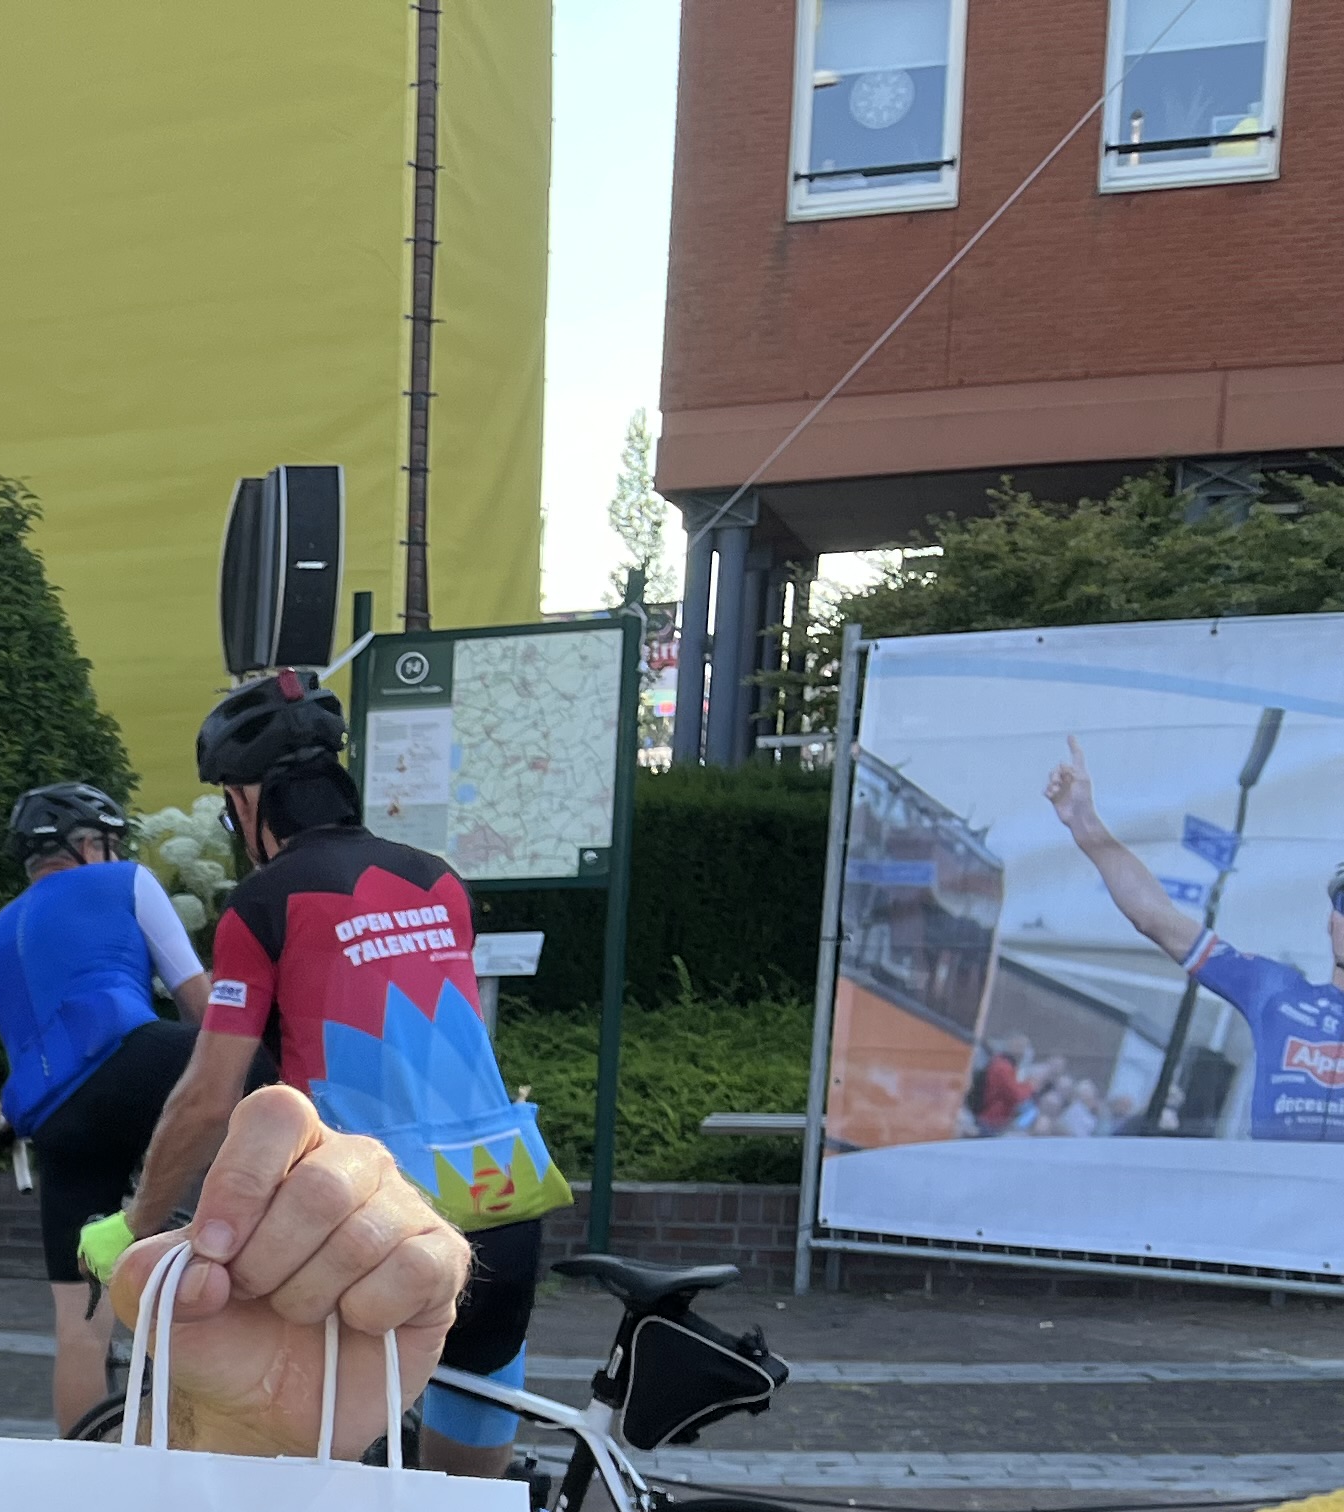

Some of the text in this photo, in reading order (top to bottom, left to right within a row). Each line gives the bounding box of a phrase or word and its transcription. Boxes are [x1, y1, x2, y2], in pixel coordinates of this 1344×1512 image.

[335, 904, 449, 942] OPEN VOOR
[343, 928, 457, 967] TALENTEN
